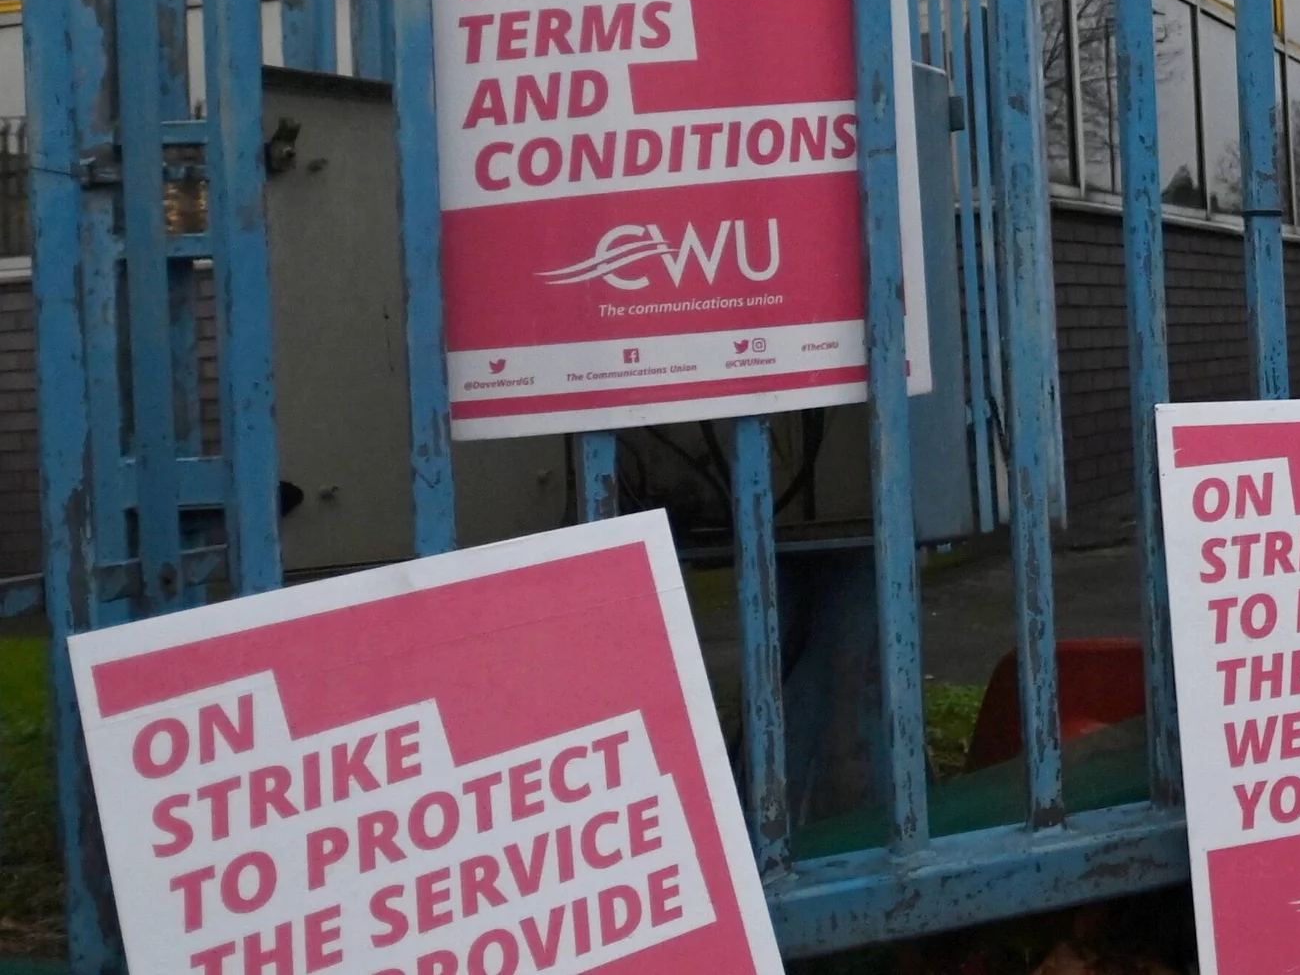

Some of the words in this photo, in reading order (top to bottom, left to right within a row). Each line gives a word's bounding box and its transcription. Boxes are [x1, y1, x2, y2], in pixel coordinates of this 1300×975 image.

[458, 0, 672, 64] TERMS
[462, 69, 609, 129] AND
[474, 113, 858, 191] CONDITIONS
[595, 218, 780, 290] CWU
[599, 305, 624, 318] The
[628, 296, 743, 315] communications
[747, 293, 784, 306] union
[464, 377, 535, 390] @DaveWardGS
[567, 373, 584, 382] The
[586, 366, 667, 381] Communications
[670, 364, 697, 374] Union
[725, 357, 776, 369] @CWUNews
[1192, 472, 1274, 522] ON
[1208, 593, 1278, 645] TO
[132, 693, 255, 779] ON
[152, 720, 421, 858] STRIKE
[170, 850, 277, 934] TO
[307, 730, 629, 890] PROTECT
[369, 795, 662, 947] SERVICE
